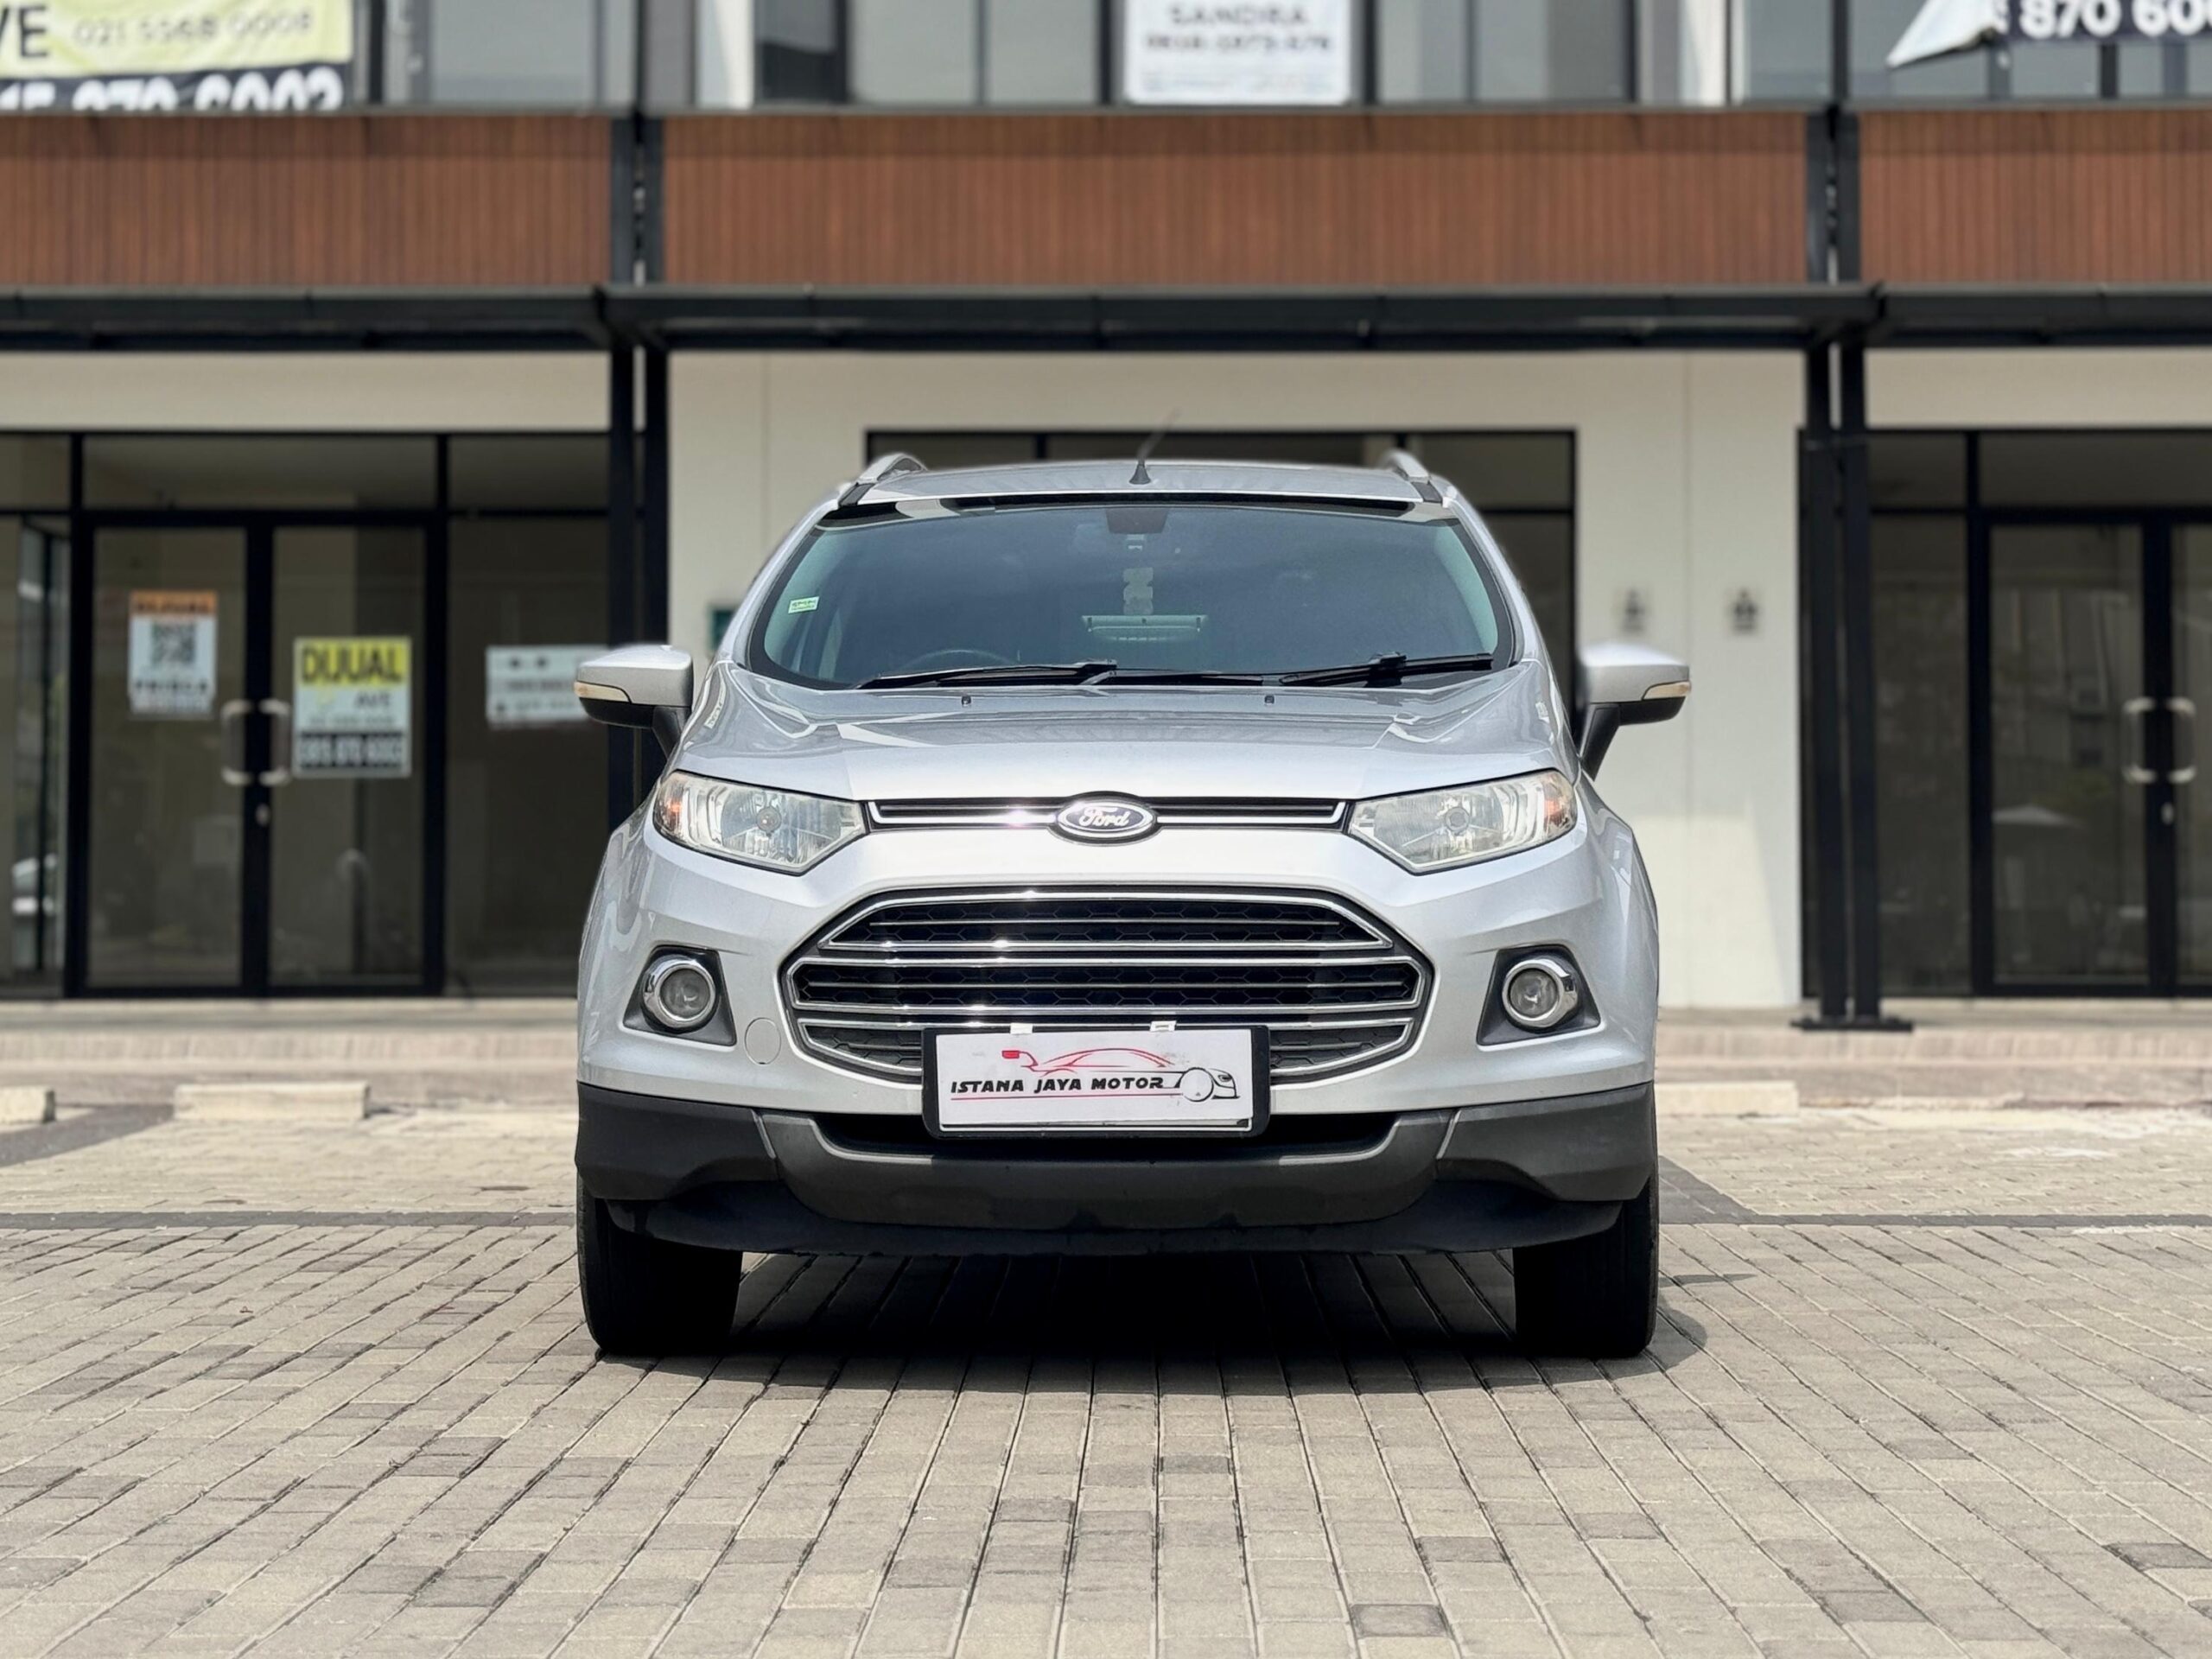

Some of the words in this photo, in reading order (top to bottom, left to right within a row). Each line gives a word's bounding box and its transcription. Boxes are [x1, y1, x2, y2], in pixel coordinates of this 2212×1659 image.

[1170, 6, 1308, 25] SANDRA
[2018, 0, 2122, 39] 870
[2131, 0, 2212, 37] 60
[1078, 805, 1131, 826] Ford
[950, 1079, 1023, 1094] ISTANA
[1034, 1077, 1082, 1094] JAYA
[1092, 1077, 1164, 1091] MOTOR
